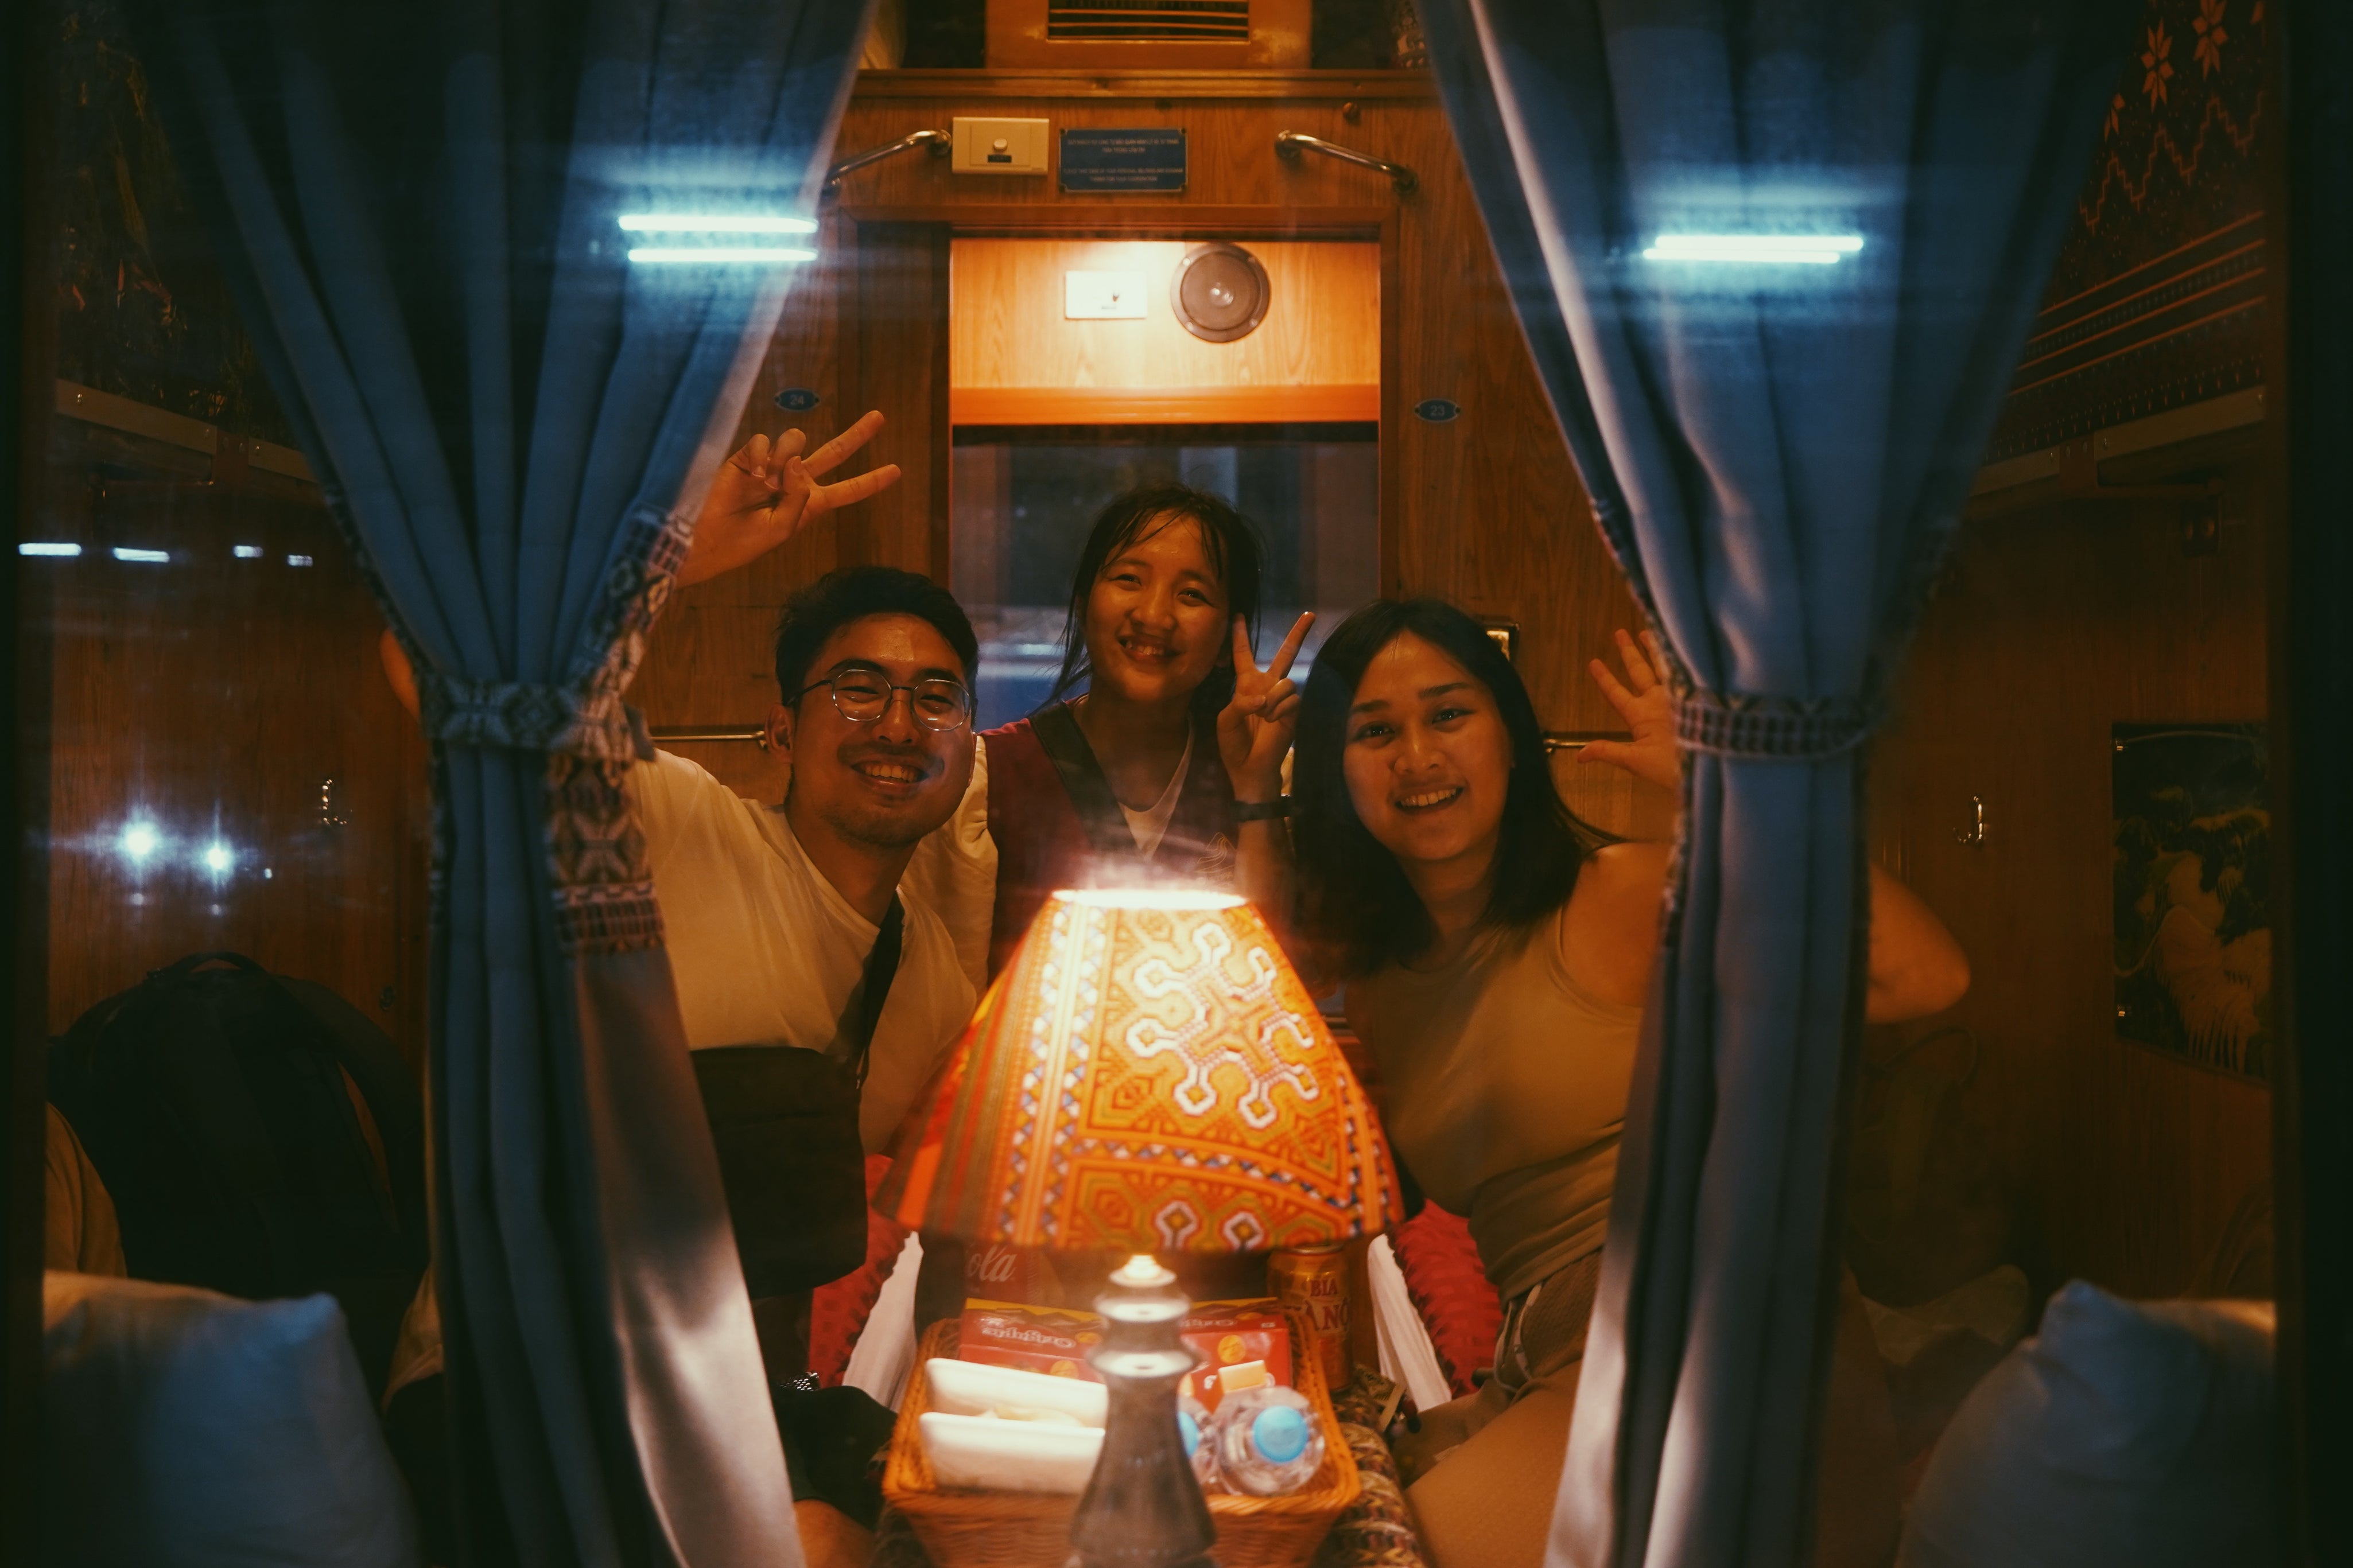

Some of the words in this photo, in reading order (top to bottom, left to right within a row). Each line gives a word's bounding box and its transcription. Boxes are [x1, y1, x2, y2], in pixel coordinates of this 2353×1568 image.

[1430, 404, 1445, 417] 23
[966, 1243, 1018, 1282] ola
[1310, 1278, 1338, 1297] BIA
